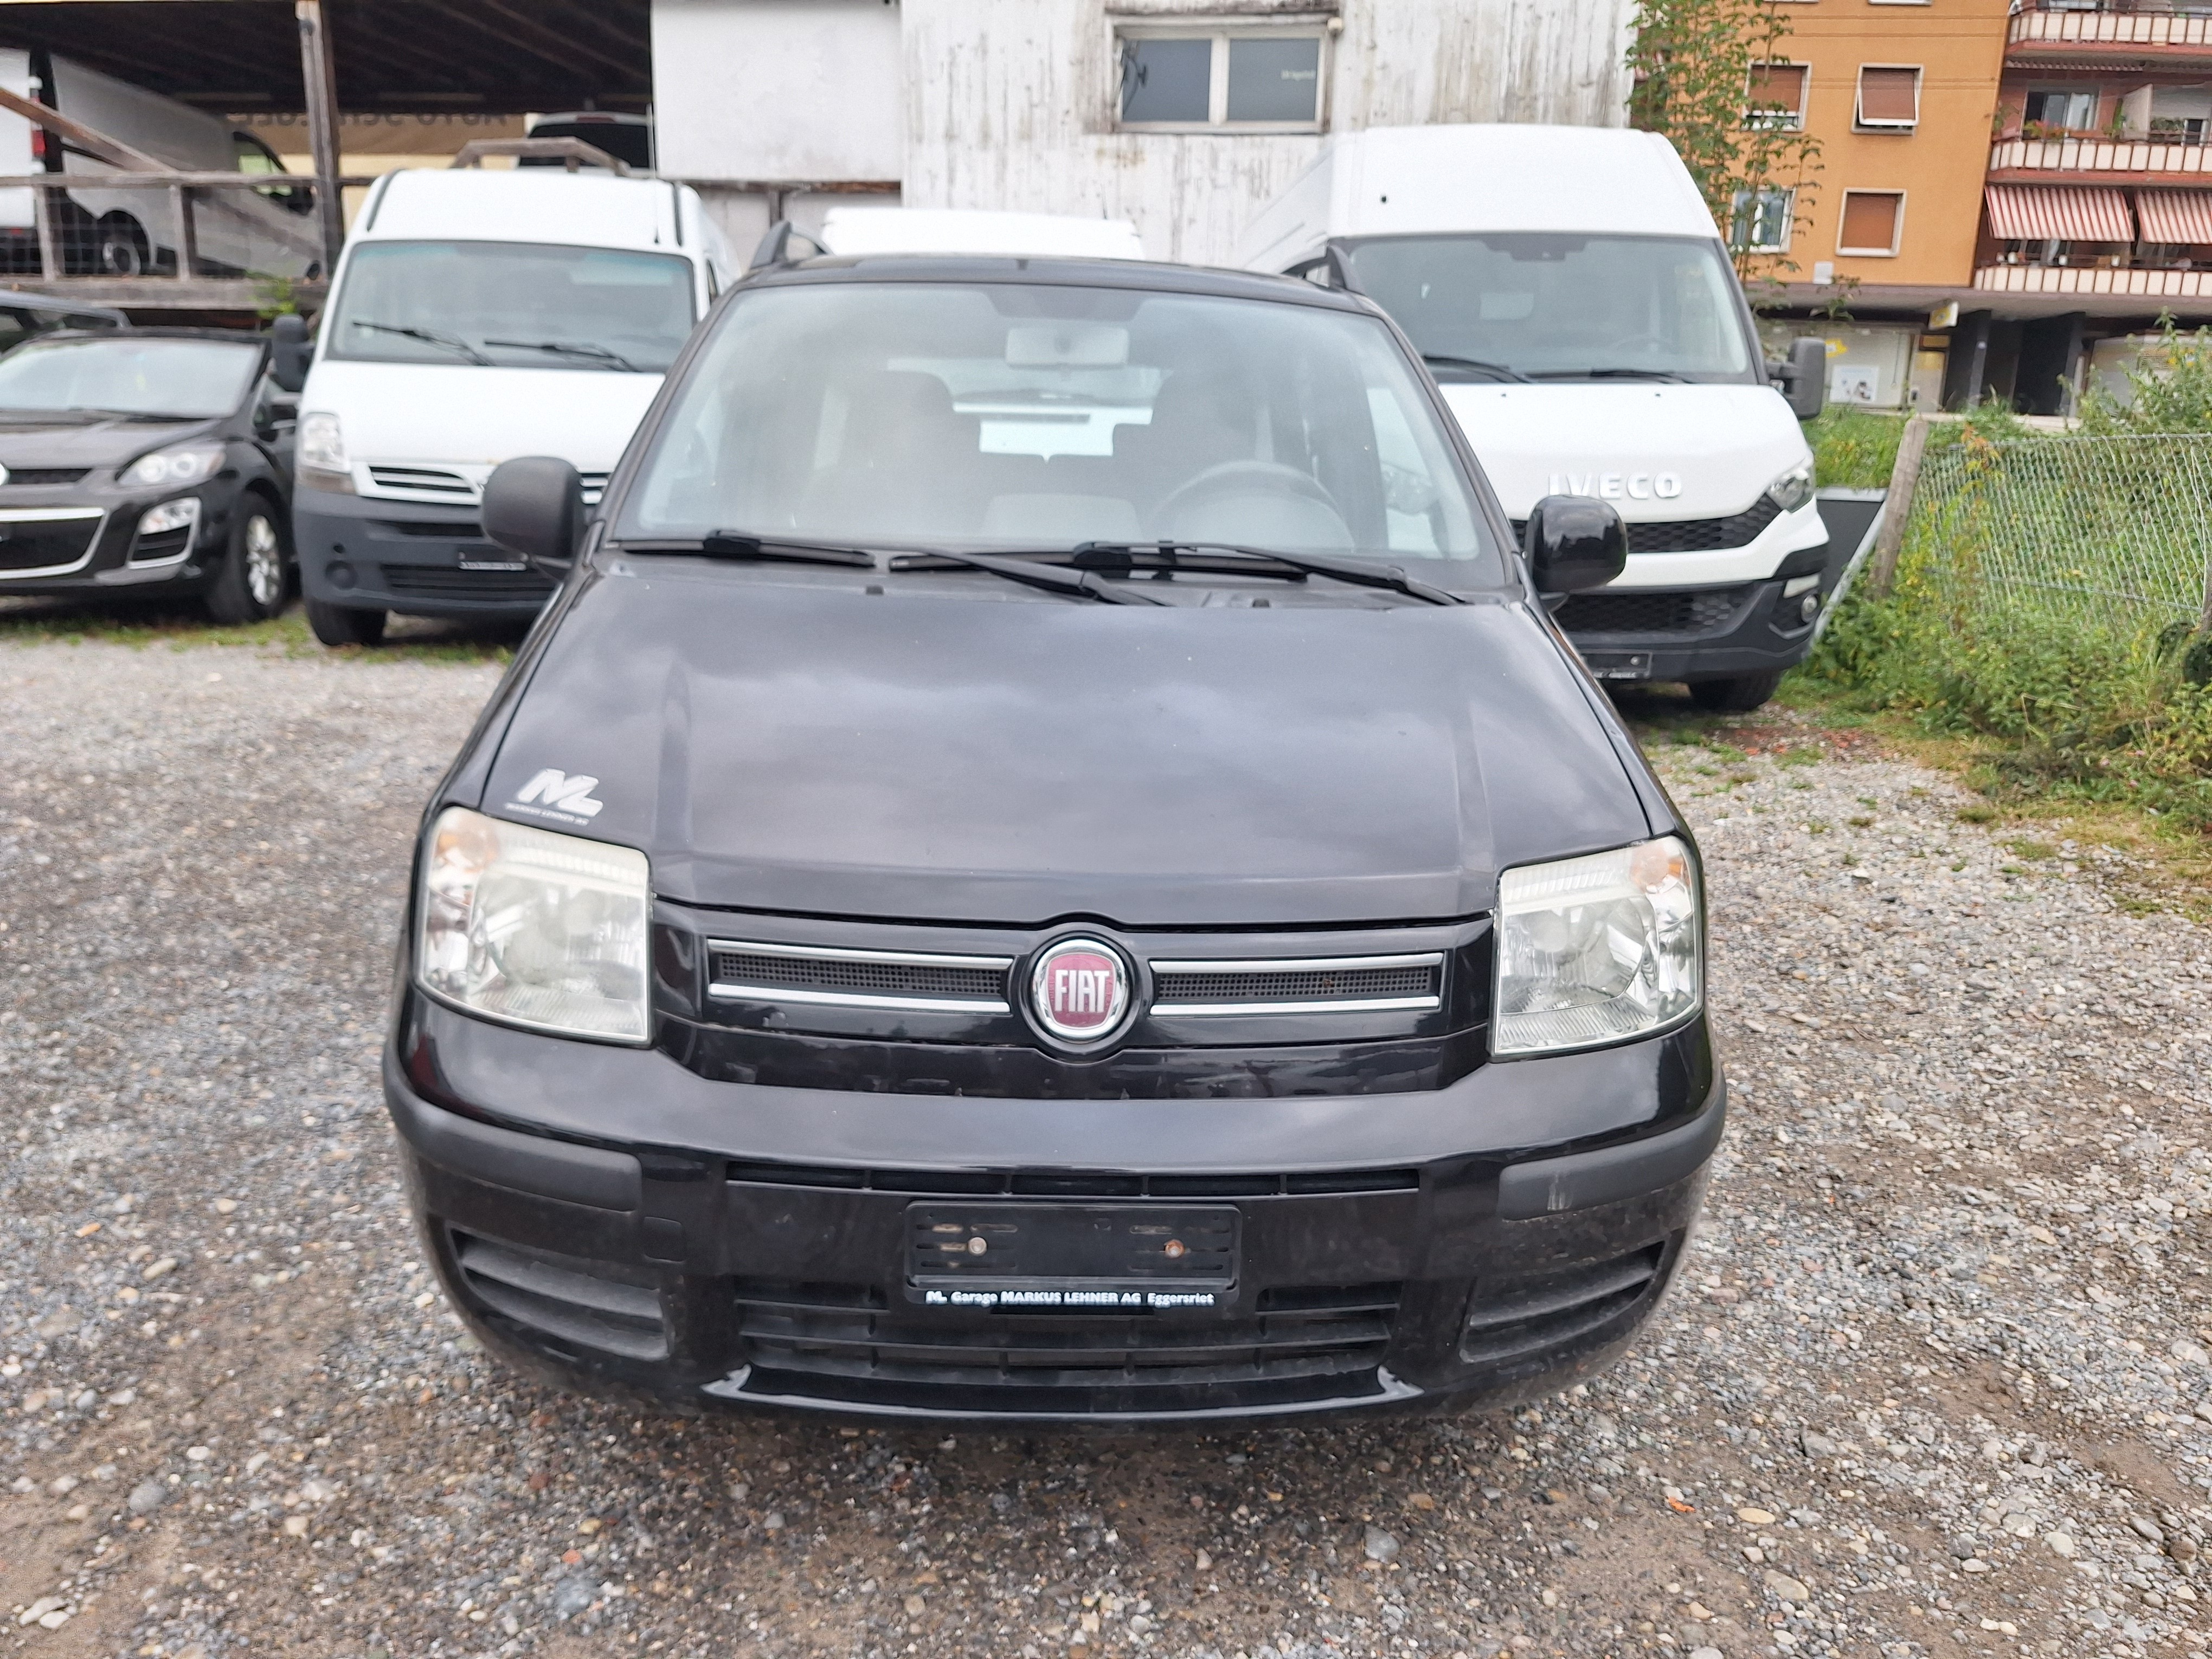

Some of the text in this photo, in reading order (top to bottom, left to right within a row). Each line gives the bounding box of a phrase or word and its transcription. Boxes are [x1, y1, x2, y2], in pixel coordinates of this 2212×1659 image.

[1548, 471, 1682, 500] IVECO
[1054, 969, 1110, 1013] FIAT
[950, 1291, 998, 1307] Garage
[1000, 1291, 1062, 1304] MARKUS
[1064, 1292, 1119, 1306] LEHNER
[1120, 1293, 1142, 1306] AG
[1147, 1293, 1216, 1309] Eggersriet
